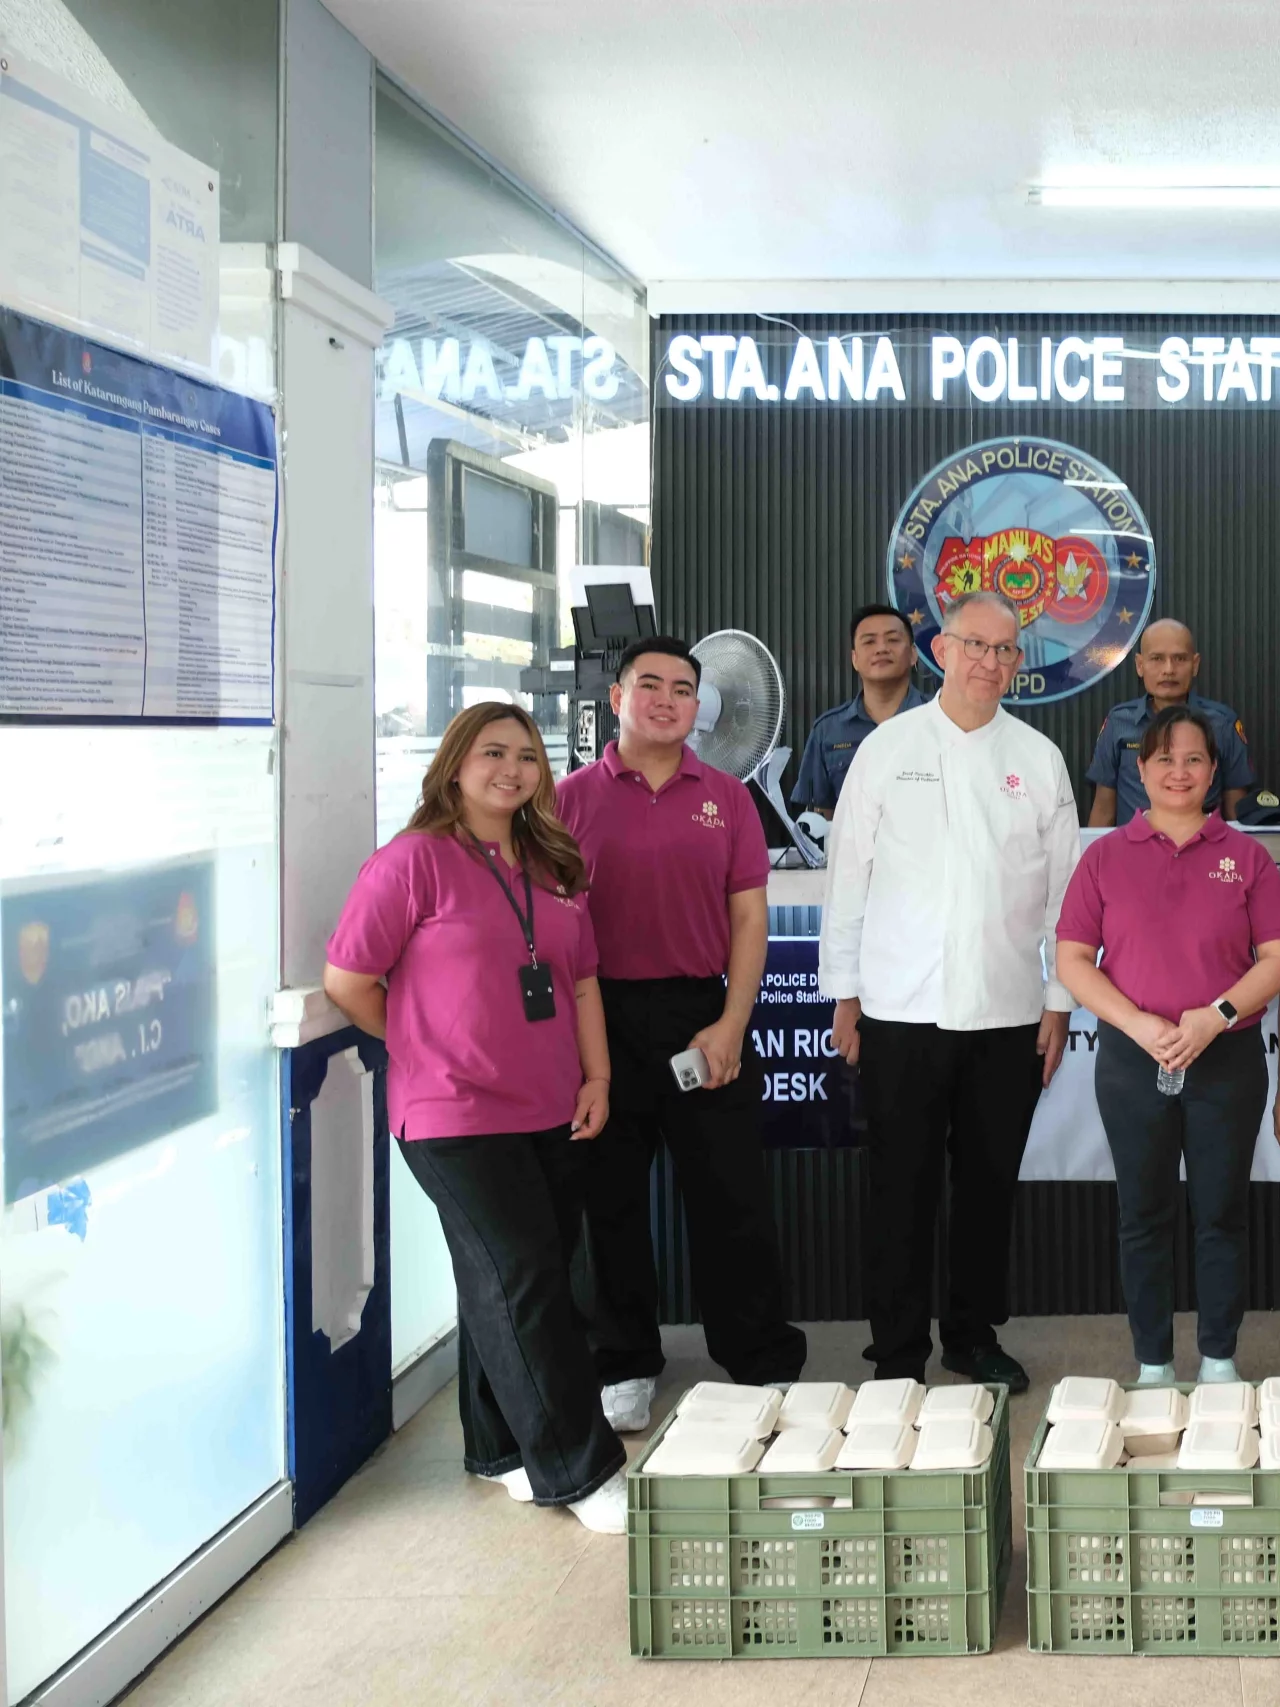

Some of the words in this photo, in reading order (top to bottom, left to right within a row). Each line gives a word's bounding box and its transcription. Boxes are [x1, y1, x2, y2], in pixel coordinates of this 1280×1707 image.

[931, 336, 1125, 402] POLICE
[52, 370, 72, 389] List
[73, 379, 84, 393] of
[84, 379, 143, 414] Katarungang
[143, 399, 200, 432] Pambarangay
[199, 419, 221, 437] Cases
[938, 459, 984, 499] ANA
[982, 446, 1066, 474] POLICE
[1064, 457, 1138, 536] STATION
[1000, 786, 1027, 798] OKADA
[691, 813, 725, 828] OKADA
[1208, 871, 1243, 882] OKADA
[766, 973, 807, 987] POLICE
[761, 990, 793, 1004] Police
[796, 990, 833, 1004] Station
